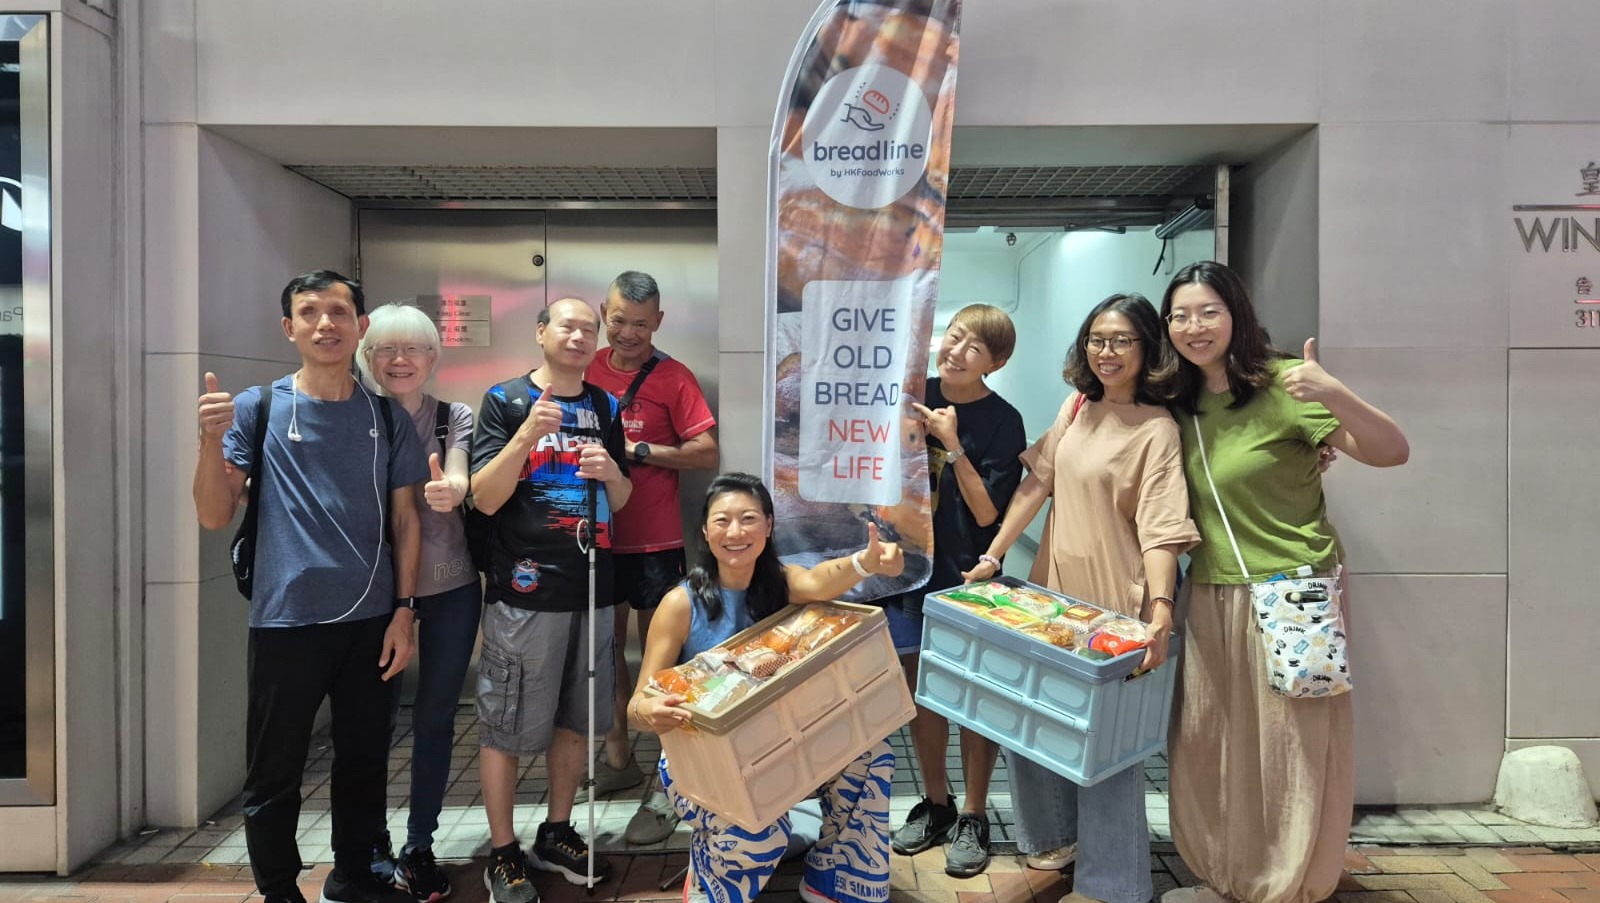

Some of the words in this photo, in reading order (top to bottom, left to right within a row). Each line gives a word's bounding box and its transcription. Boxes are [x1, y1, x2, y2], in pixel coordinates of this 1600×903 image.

[814, 140, 924, 161] breadline
[831, 168, 842, 178] by
[844, 167, 905, 177] HKFoodWorks
[832, 308, 896, 332] GIVE
[833, 345, 893, 369] OLD
[814, 382, 899, 406] BREAD
[828, 419, 891, 443] NEW
[833, 456, 885, 480] LIFE
